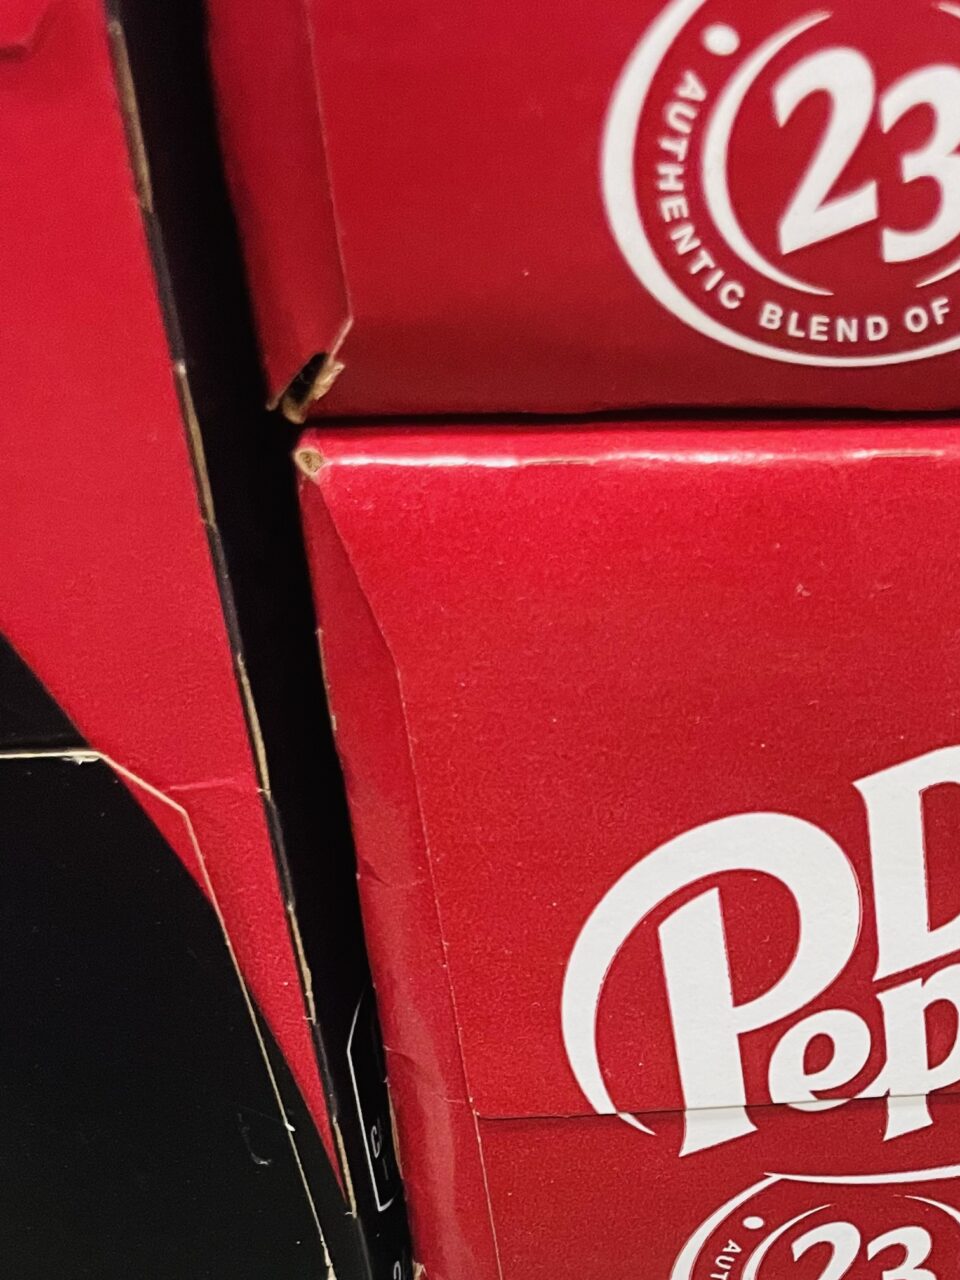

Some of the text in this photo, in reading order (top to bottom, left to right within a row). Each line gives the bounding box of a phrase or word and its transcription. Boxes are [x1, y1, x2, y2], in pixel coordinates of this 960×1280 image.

[657, 70, 746, 311] AUTHENTIC
[759, 302, 889, 343] BLEND
[904, 297, 951, 333] OF
